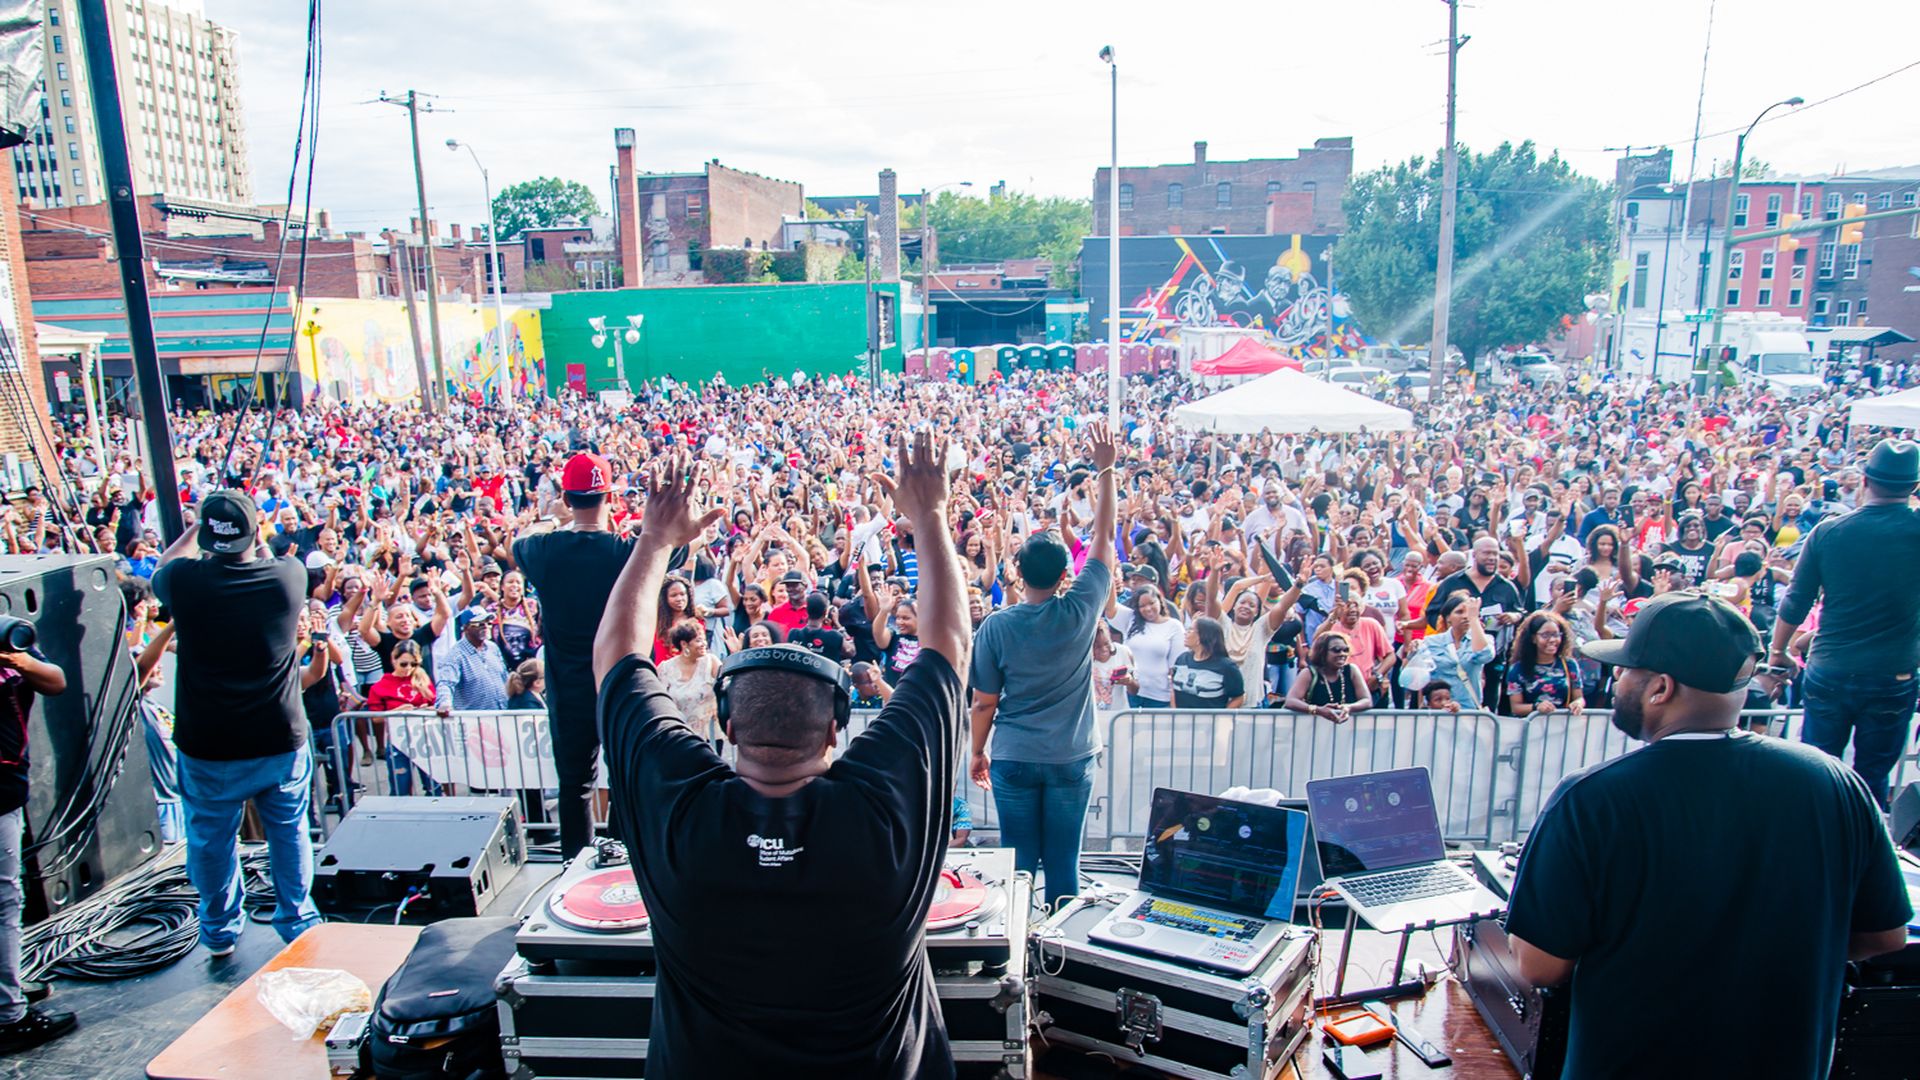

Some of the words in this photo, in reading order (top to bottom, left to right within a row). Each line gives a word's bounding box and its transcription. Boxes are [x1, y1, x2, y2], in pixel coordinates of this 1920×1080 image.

[742, 648, 770, 660] beats
[772, 649, 789, 661] by
[802, 654, 822, 669] dre
